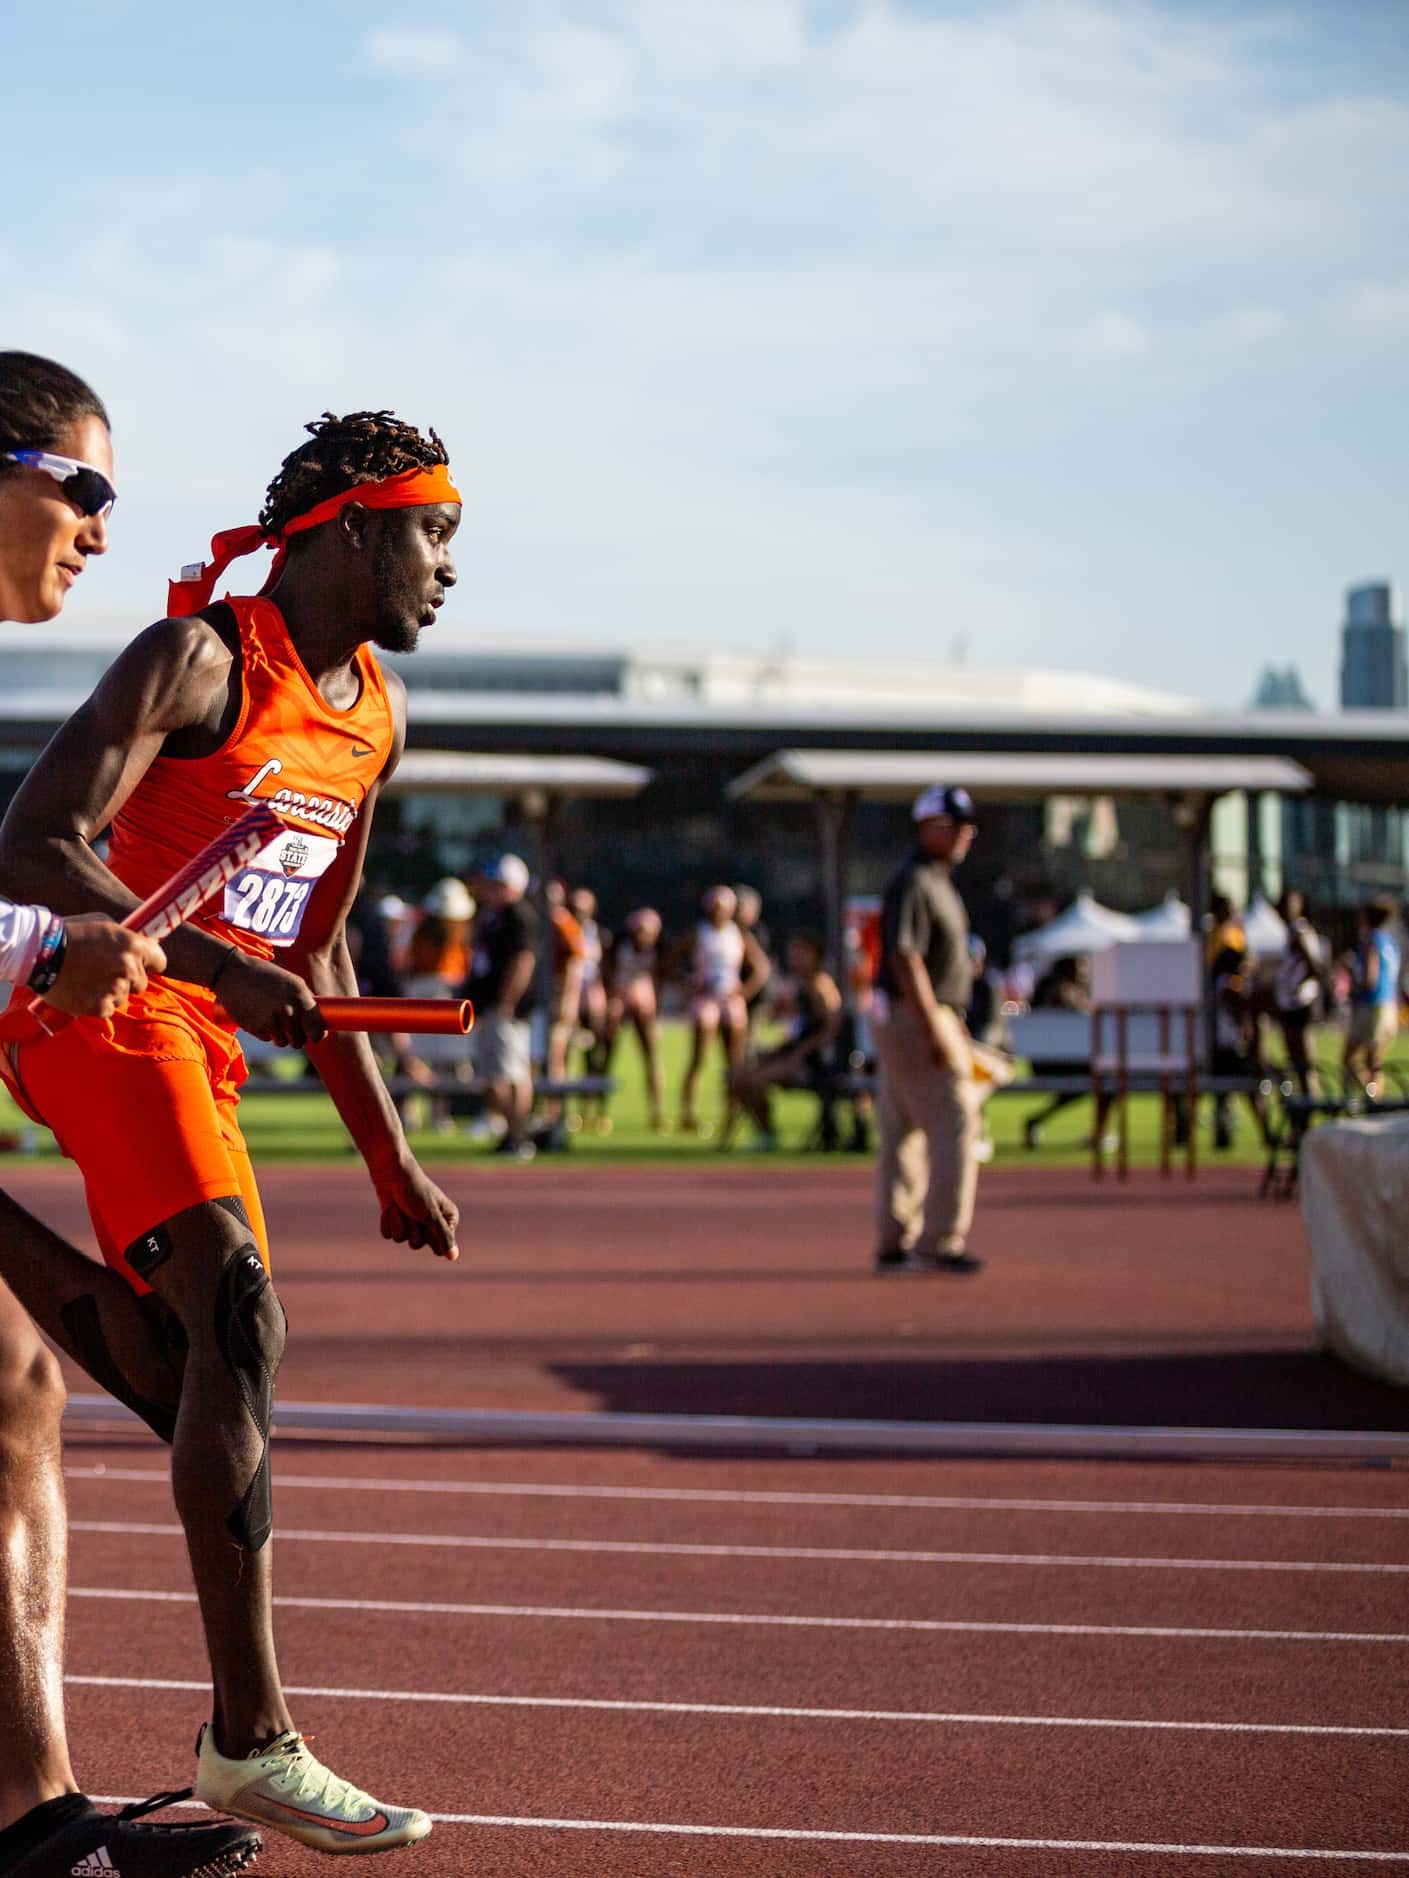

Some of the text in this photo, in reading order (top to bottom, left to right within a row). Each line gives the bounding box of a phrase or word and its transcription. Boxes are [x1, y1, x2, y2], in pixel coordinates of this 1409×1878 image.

[138, 831, 261, 942] RIZZLY
[233, 873, 310, 934] 2873
[147, 1236, 160, 1252] KT
[71, 1864, 121, 1878] adidas
